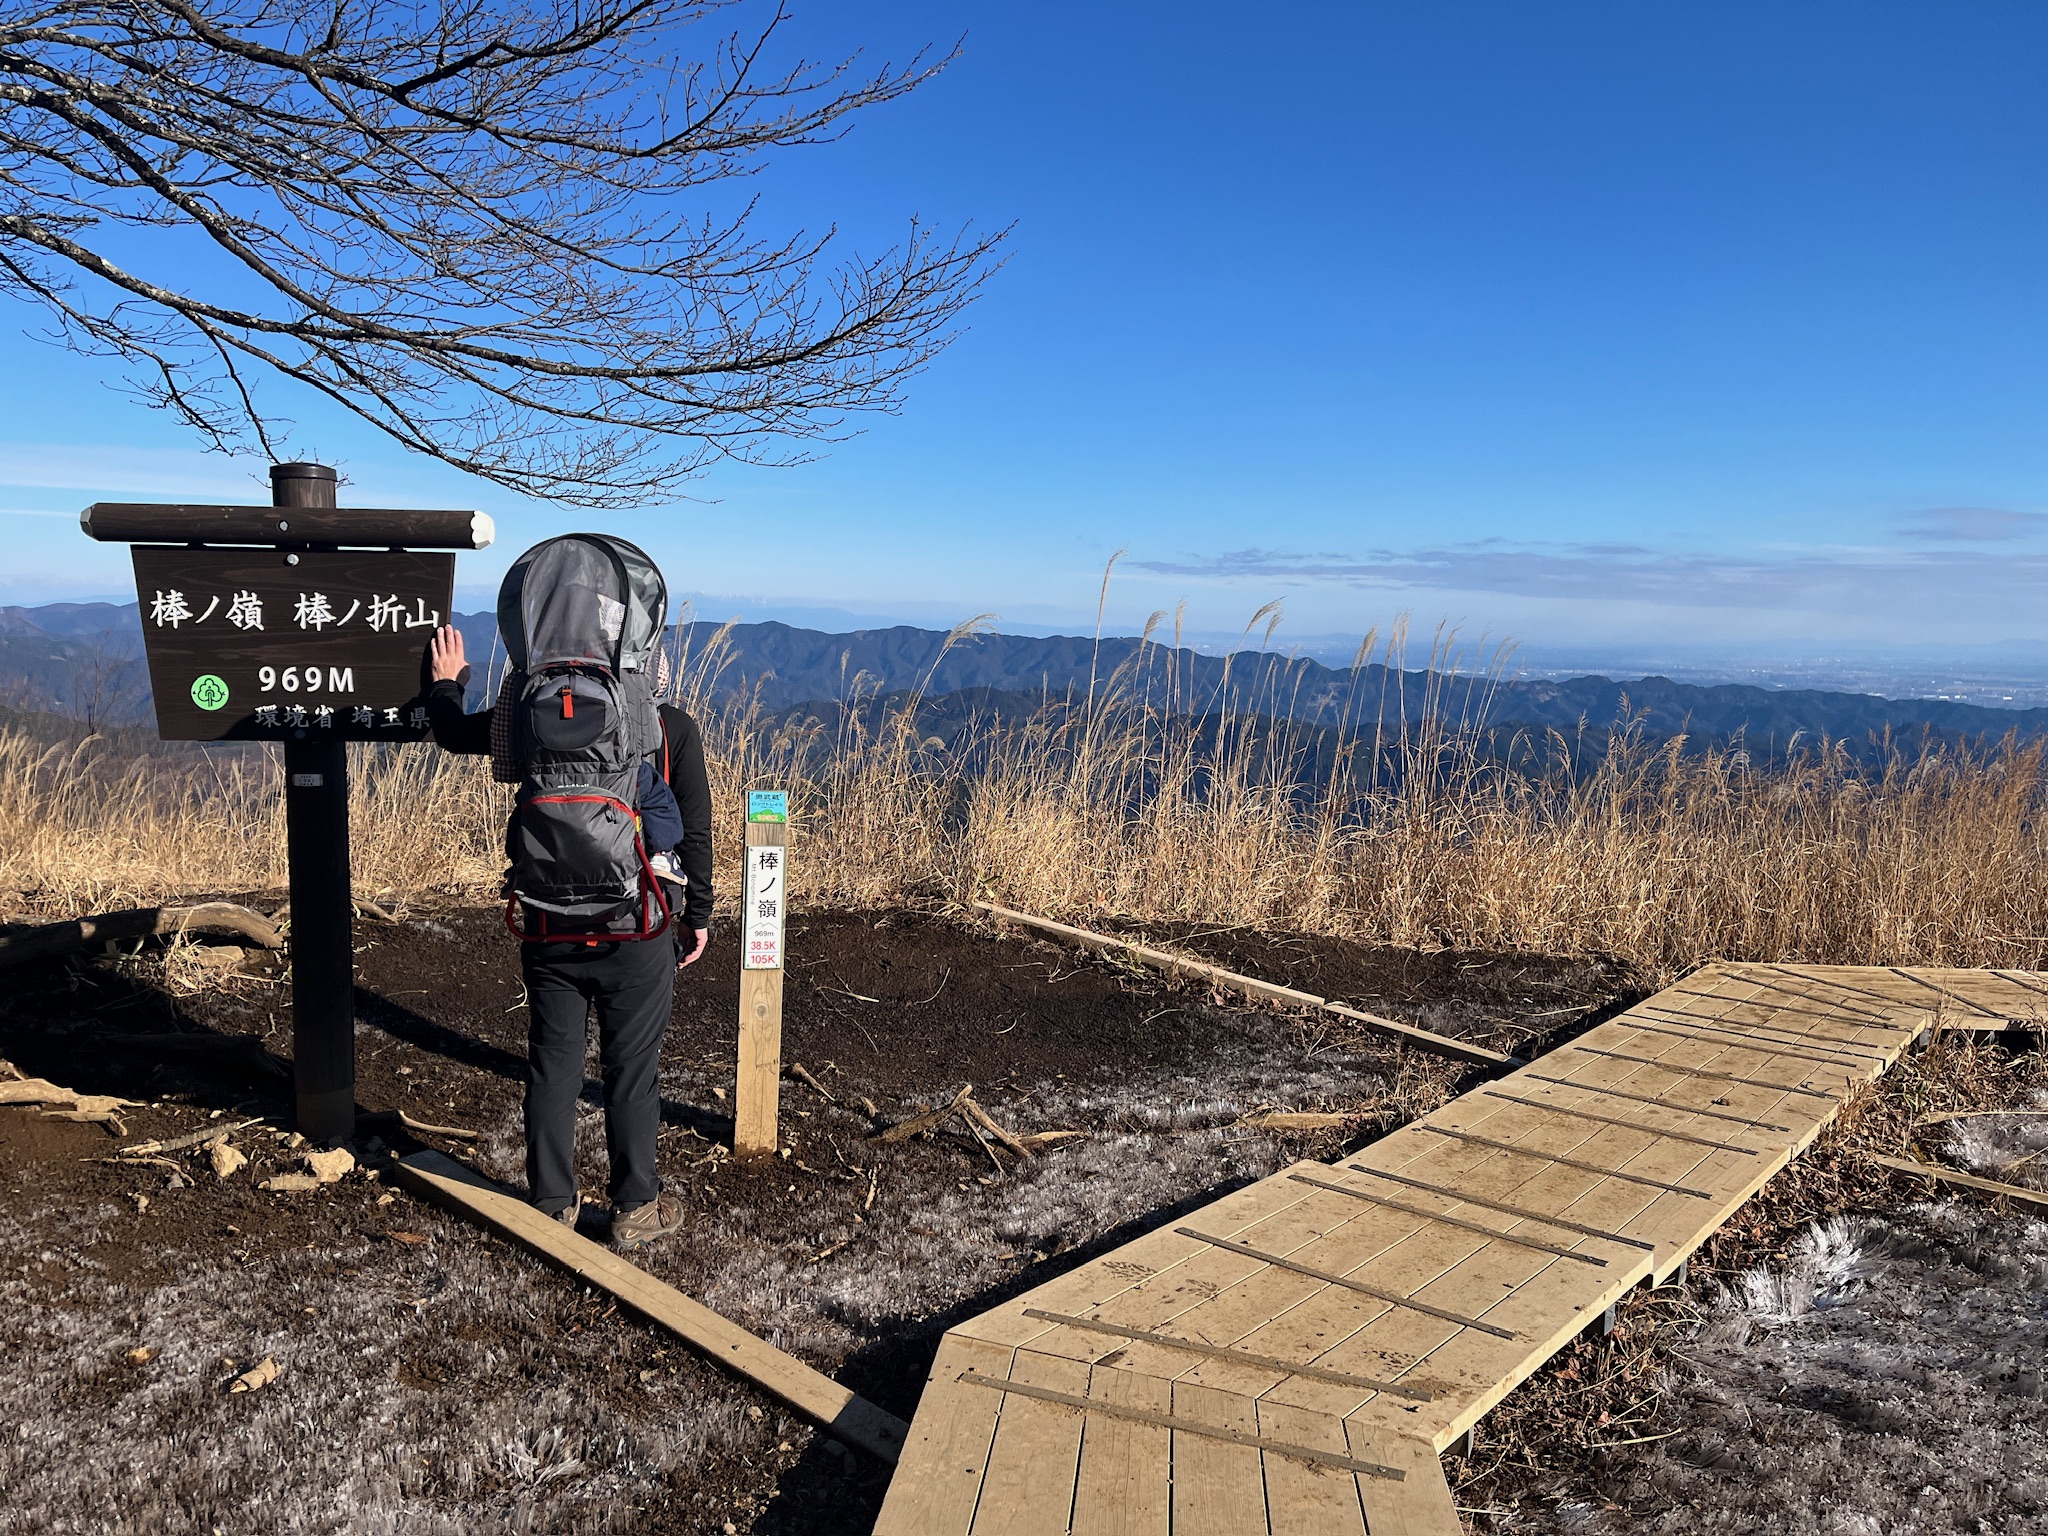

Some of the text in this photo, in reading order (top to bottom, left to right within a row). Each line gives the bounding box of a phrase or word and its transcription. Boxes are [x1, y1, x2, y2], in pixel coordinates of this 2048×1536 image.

[149, 589, 440, 633] 棒ノ嶺 棒ノ折山
[257, 666, 355, 693] 969M
[254, 705, 431, 730] 環境省 埼玉県
[758, 851, 778, 918] 棒ノ嶺
[750, 941, 776, 950] 38.5K
[750, 955, 776, 964] 105K
